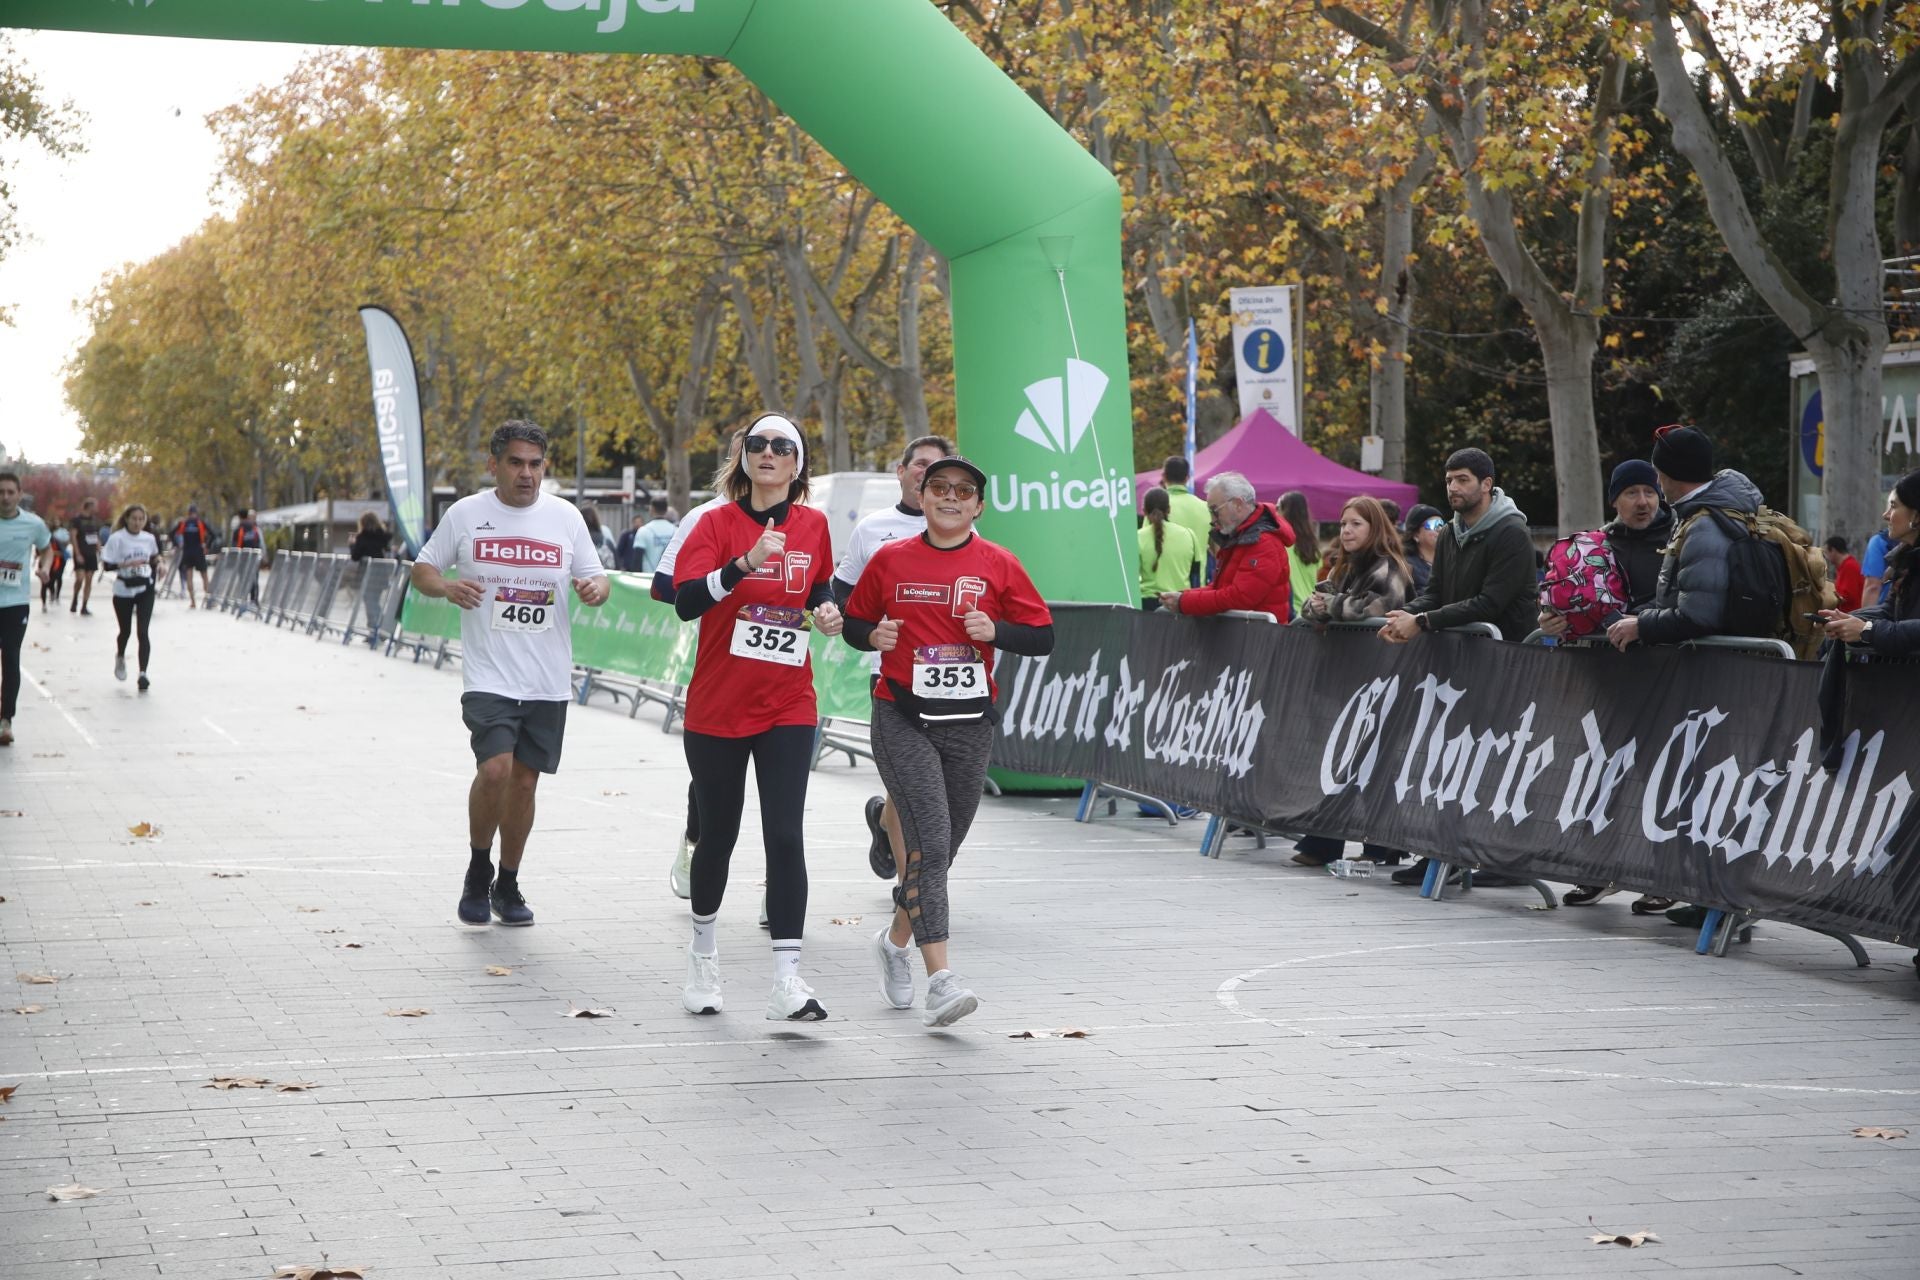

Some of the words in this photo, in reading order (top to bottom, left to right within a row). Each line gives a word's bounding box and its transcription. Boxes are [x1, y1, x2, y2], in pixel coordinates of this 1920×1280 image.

[990, 467, 1131, 519] Unicaja
[480, 542, 558, 564] Helios
[513, 576, 527, 584] del
[501, 605, 545, 625] 460
[745, 625, 797, 654] 352
[924, 666, 976, 688] 353
[1320, 674, 1400, 796] El
[1394, 673, 1554, 826] Norte
[1555, 709, 1637, 836] de
[1642, 705, 1915, 879] Castilla
